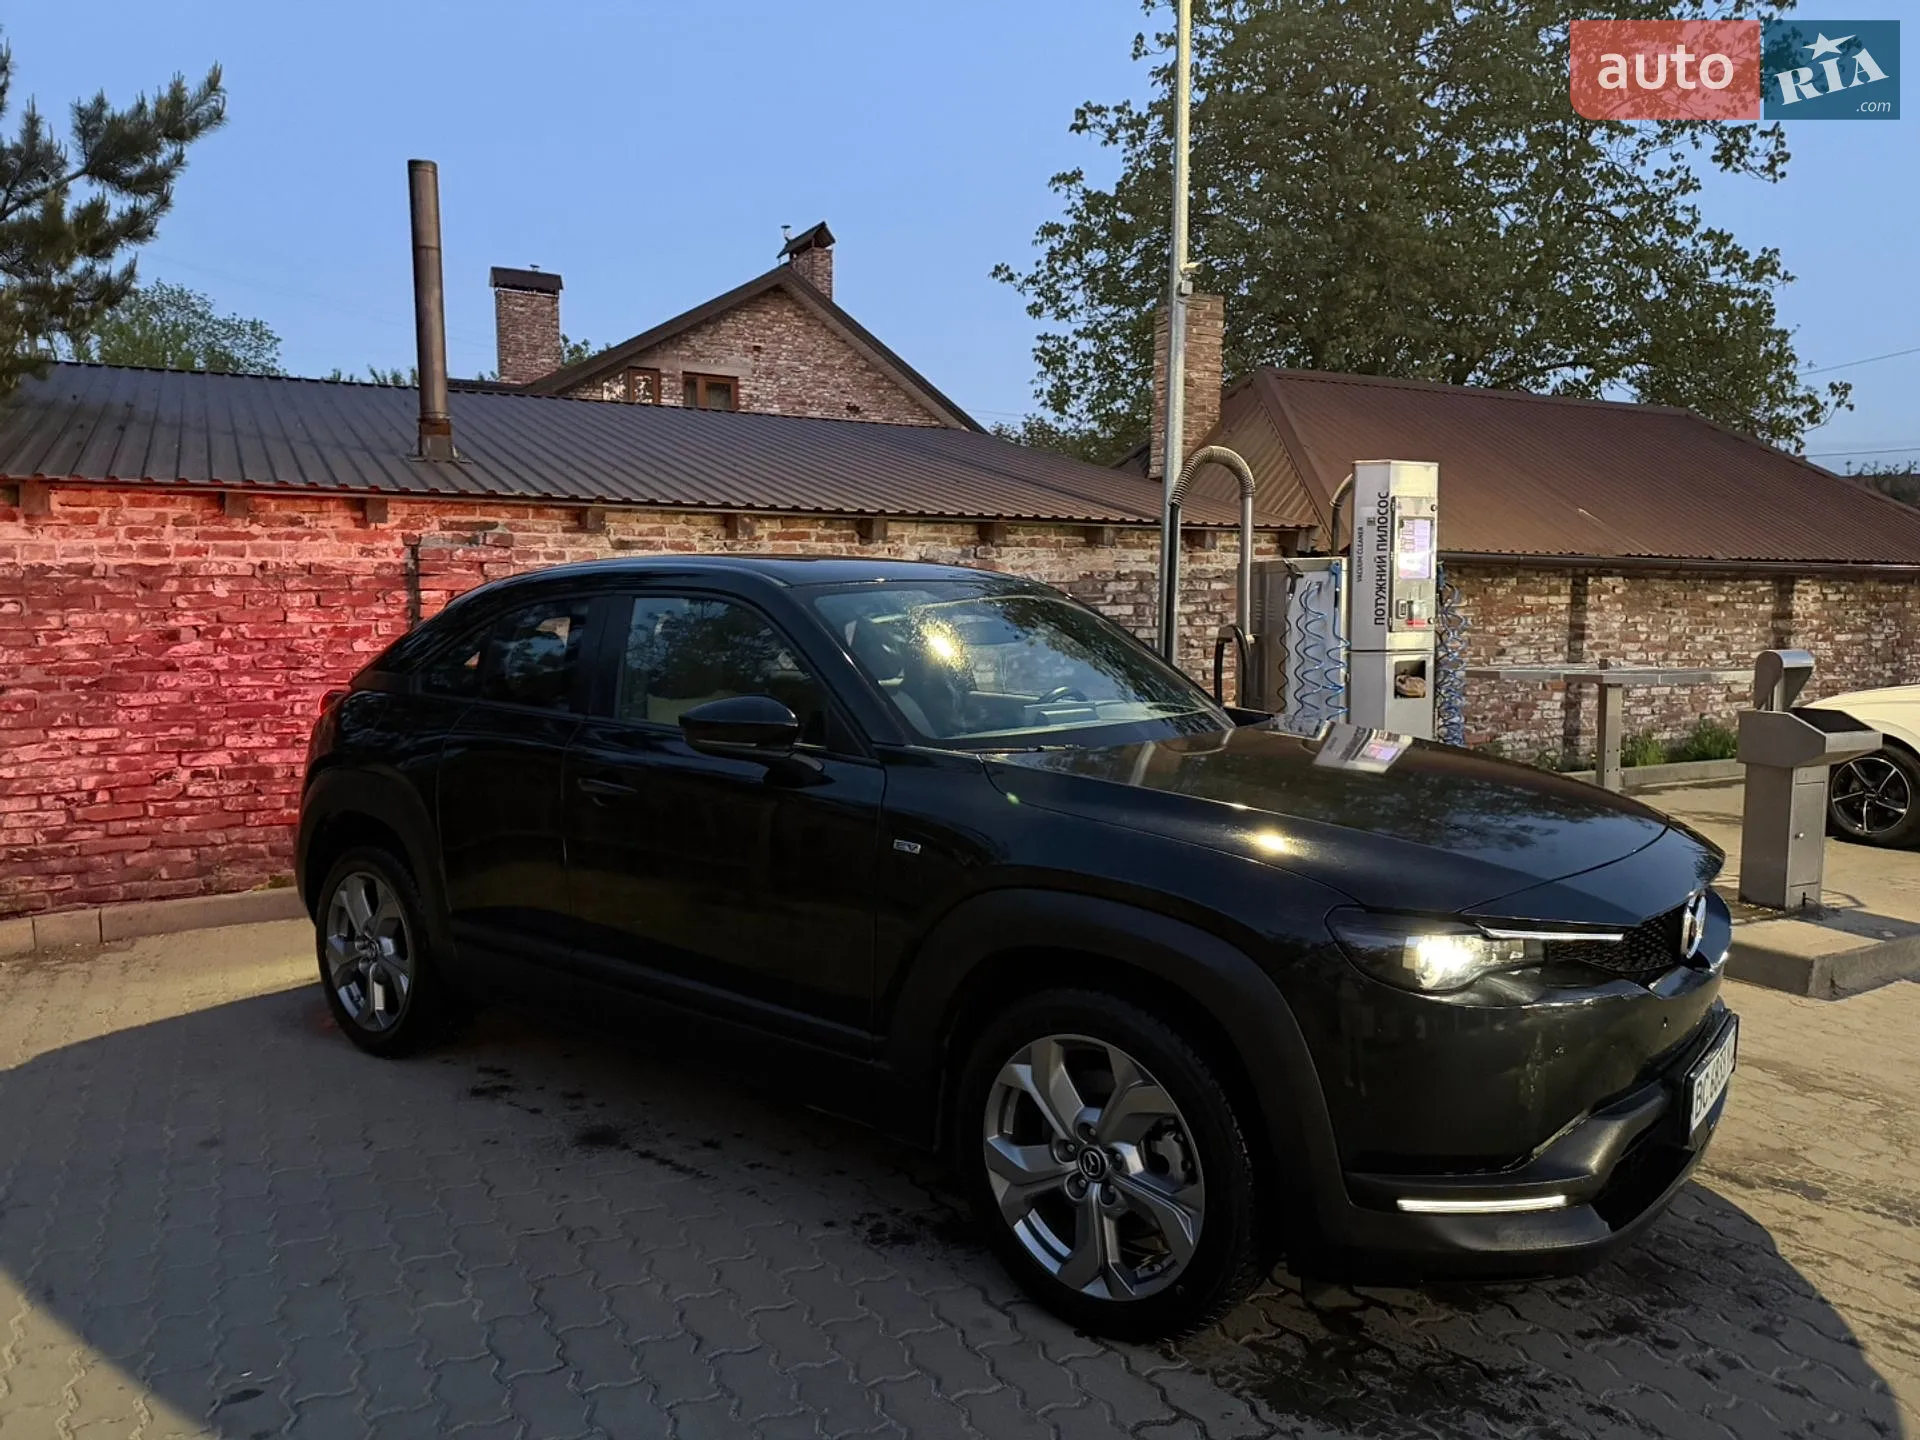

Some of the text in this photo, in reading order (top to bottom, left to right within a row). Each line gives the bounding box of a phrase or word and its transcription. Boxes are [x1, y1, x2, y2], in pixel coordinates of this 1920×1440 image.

[1356, 526, 1364, 555] CLEANER
[1374, 491, 1390, 626] ПОТУЖНИЙ ПИЛОСОС
